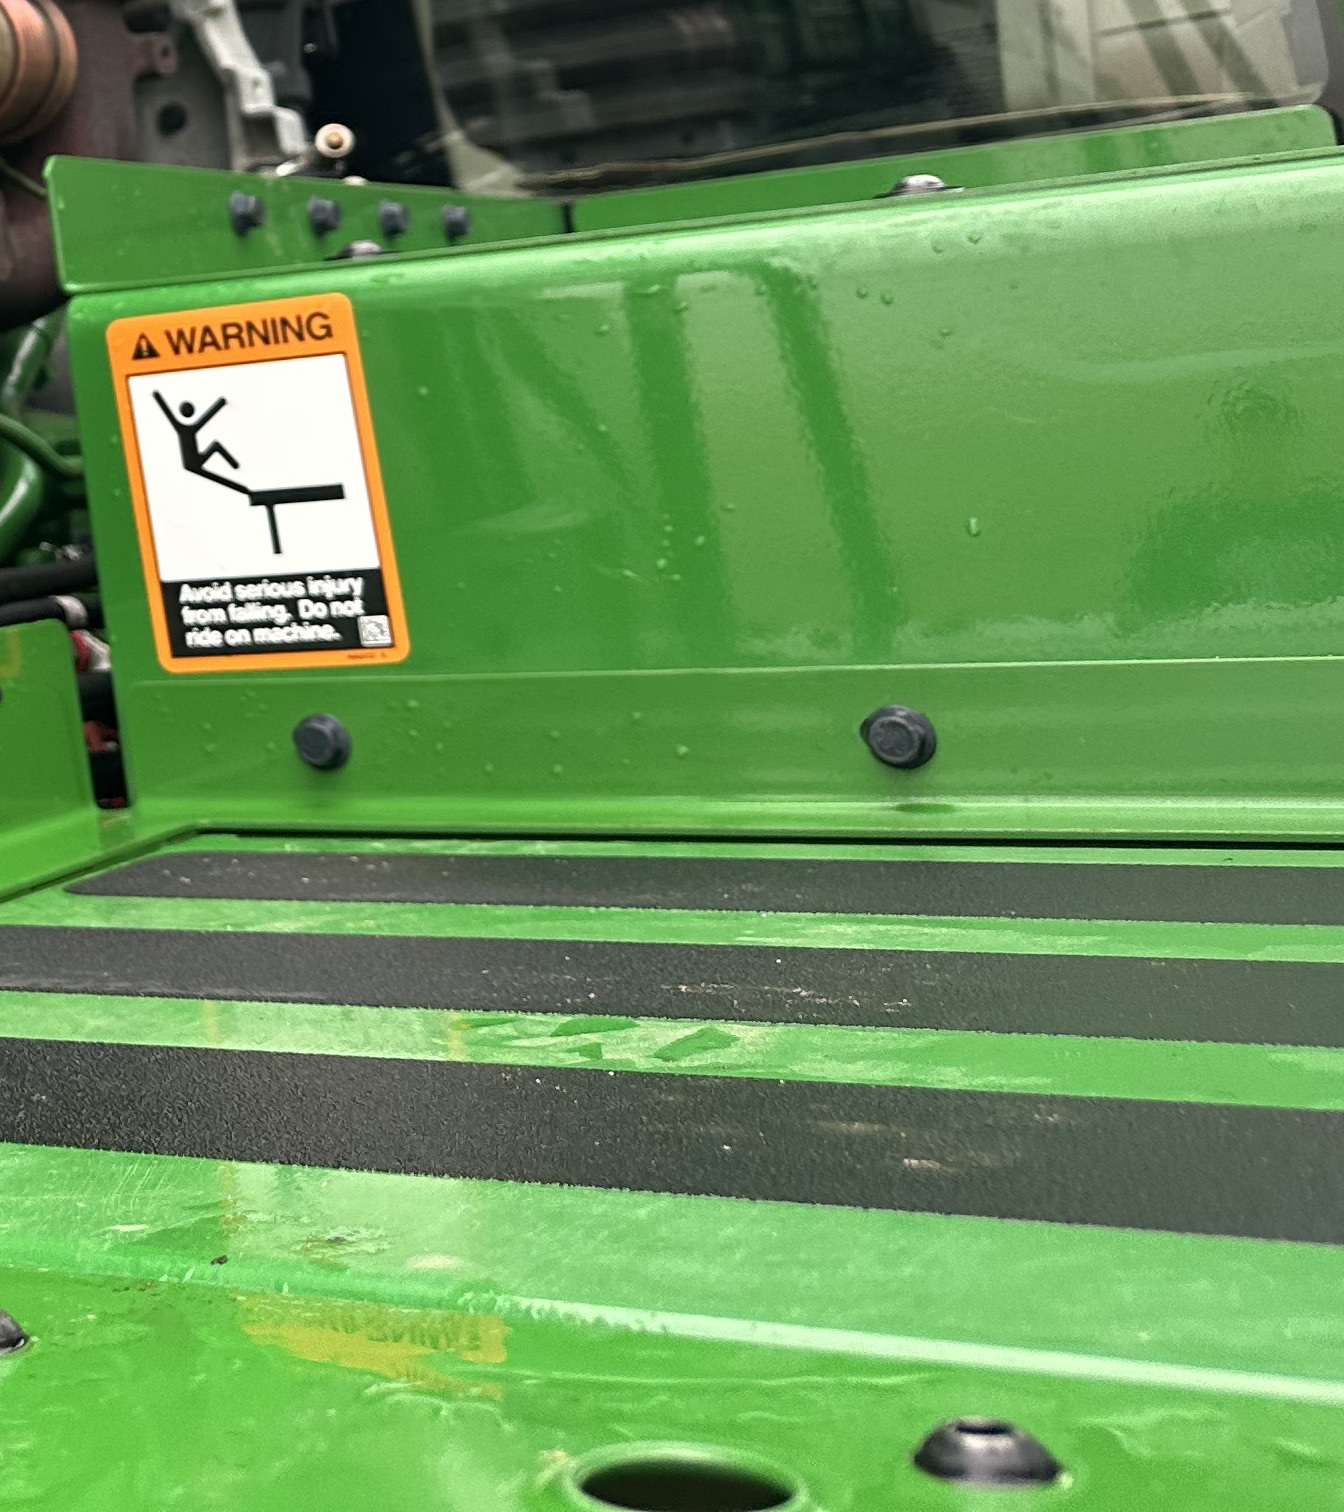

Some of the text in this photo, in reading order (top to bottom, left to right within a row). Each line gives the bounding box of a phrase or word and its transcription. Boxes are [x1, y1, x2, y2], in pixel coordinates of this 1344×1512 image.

[164, 311, 333, 355] WARNING
[179, 575, 364, 605] Avoid serious injury
[181, 596, 365, 626] from falling. Do not
[185, 621, 343, 649] ride on machine.
